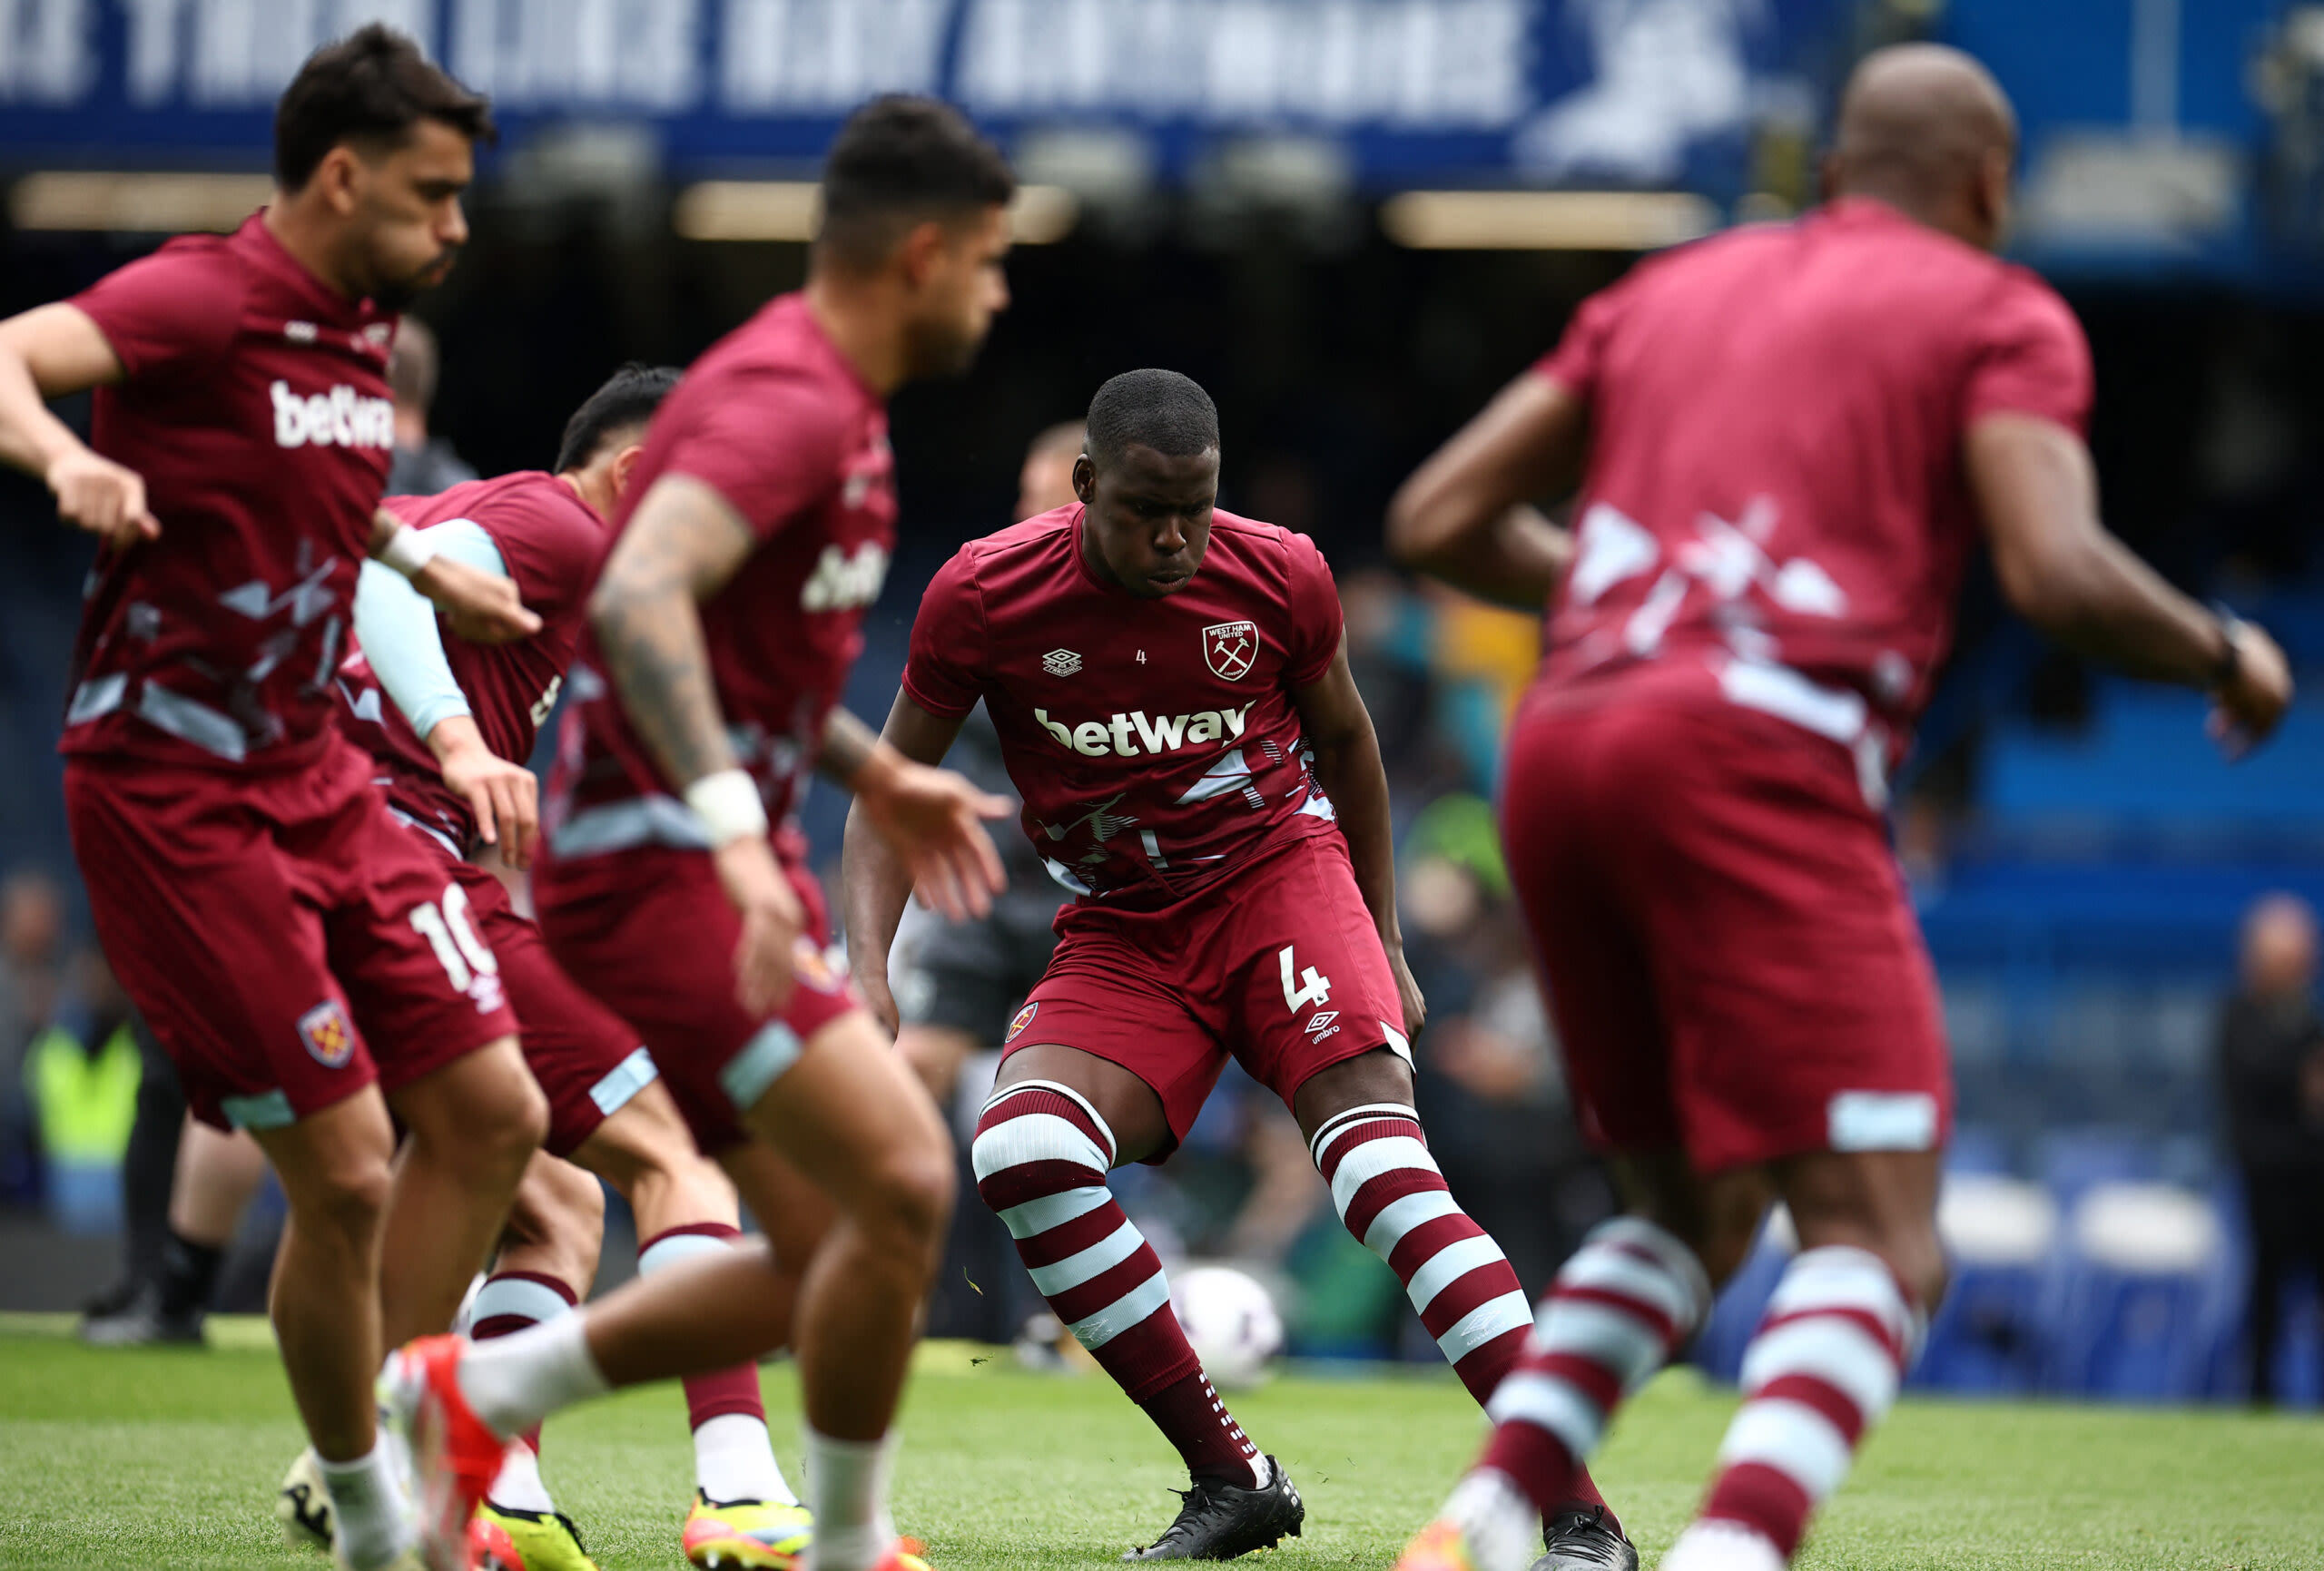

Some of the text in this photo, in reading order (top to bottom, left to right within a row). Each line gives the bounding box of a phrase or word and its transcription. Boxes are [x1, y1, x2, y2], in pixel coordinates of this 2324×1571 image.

[1208, 623, 1252, 637] WEST HAM
[1218, 631, 1244, 640] UNITED
[1135, 649, 1147, 665] 4
[1224, 668, 1244, 676] LONDON
[1034, 699, 1257, 757] betway
[1278, 945, 1332, 1015] 4
[1311, 1024, 1341, 1045] umbro
